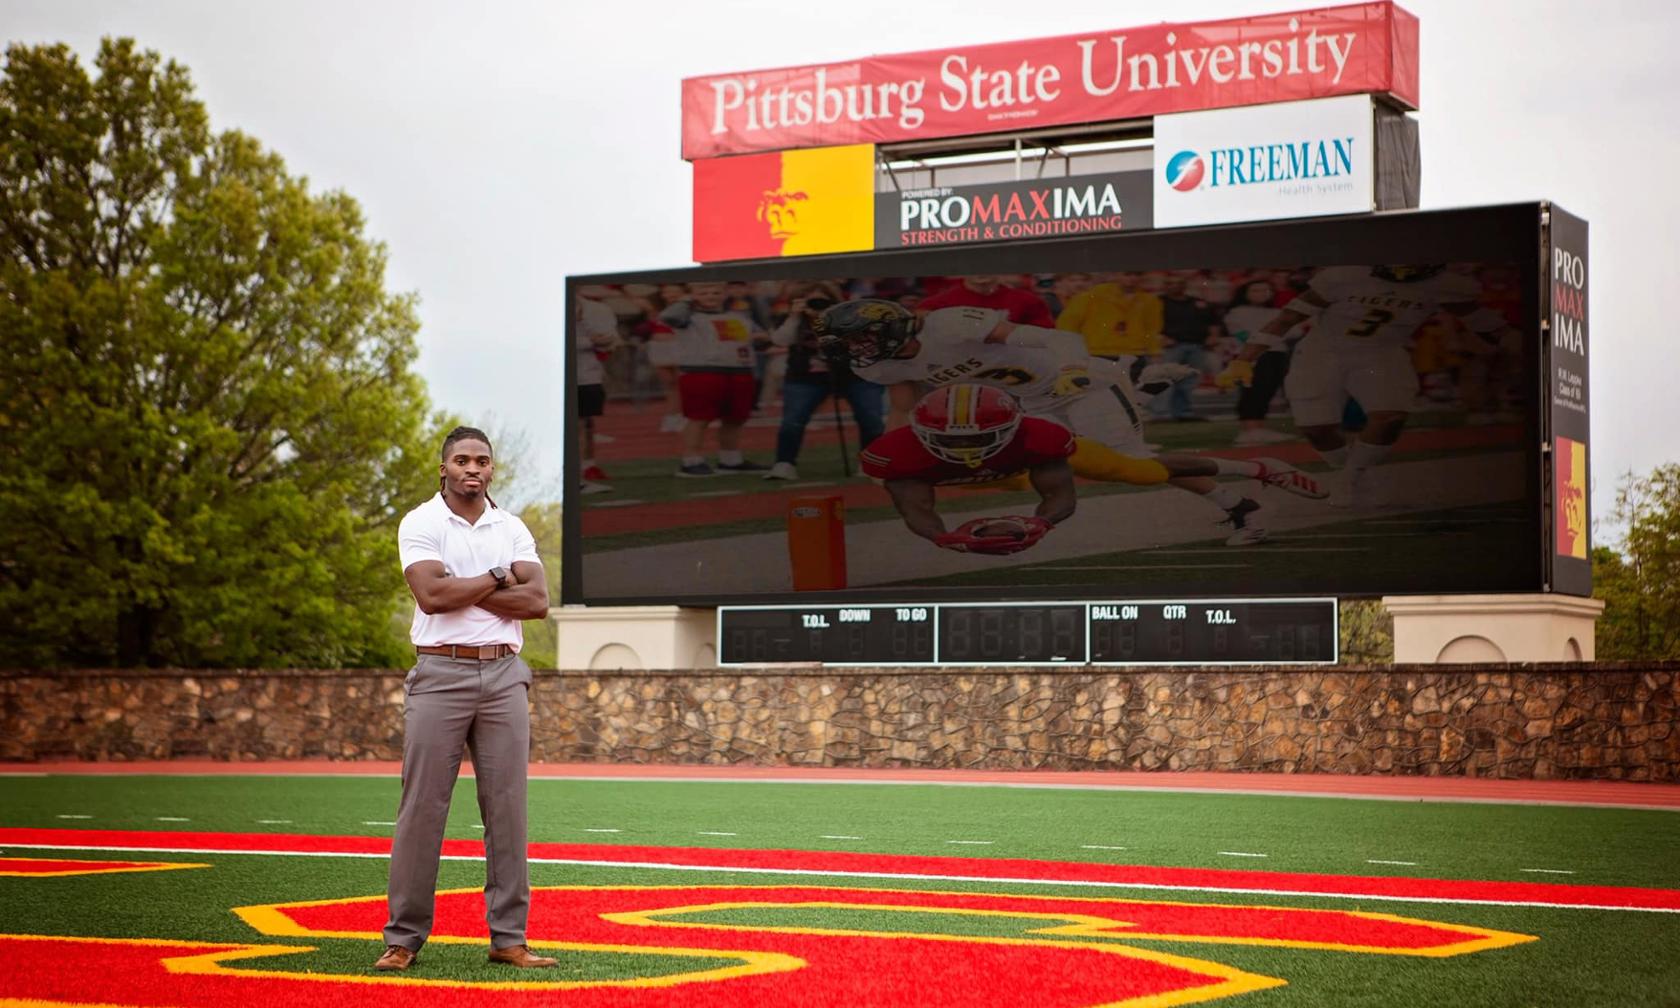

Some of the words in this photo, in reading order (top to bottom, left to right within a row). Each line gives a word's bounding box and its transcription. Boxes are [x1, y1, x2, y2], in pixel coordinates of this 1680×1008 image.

[709, 67, 925, 136] Pittsburg
[939, 55, 1061, 112] State
[1078, 17, 1357, 96] University
[1210, 137, 1354, 187] FREEMAN
[901, 189, 940, 199] POWERED
[1278, 183, 1313, 196] Health
[1316, 181, 1354, 194] System
[900, 183, 1122, 231] PROMAXIMA
[900, 227, 979, 246] STRENGTH
[983, 227, 994, 239] &
[999, 215, 1122, 239] CONDITIONING
[1555, 247, 1584, 290] PRO
[1554, 282, 1584, 321] MAX
[1345, 308, 1395, 337] 3
[1555, 312, 1584, 356] IMA
[802, 614, 830, 628] T.O.L.
[839, 609, 871, 622] DOWN
[896, 608, 910, 621] TO
[911, 608, 927, 621] GO
[1092, 605, 1120, 620] BALL
[1122, 605, 1138, 619] ON
[1163, 605, 1186, 619] QTR
[1206, 610, 1236, 624] T.O.L.
